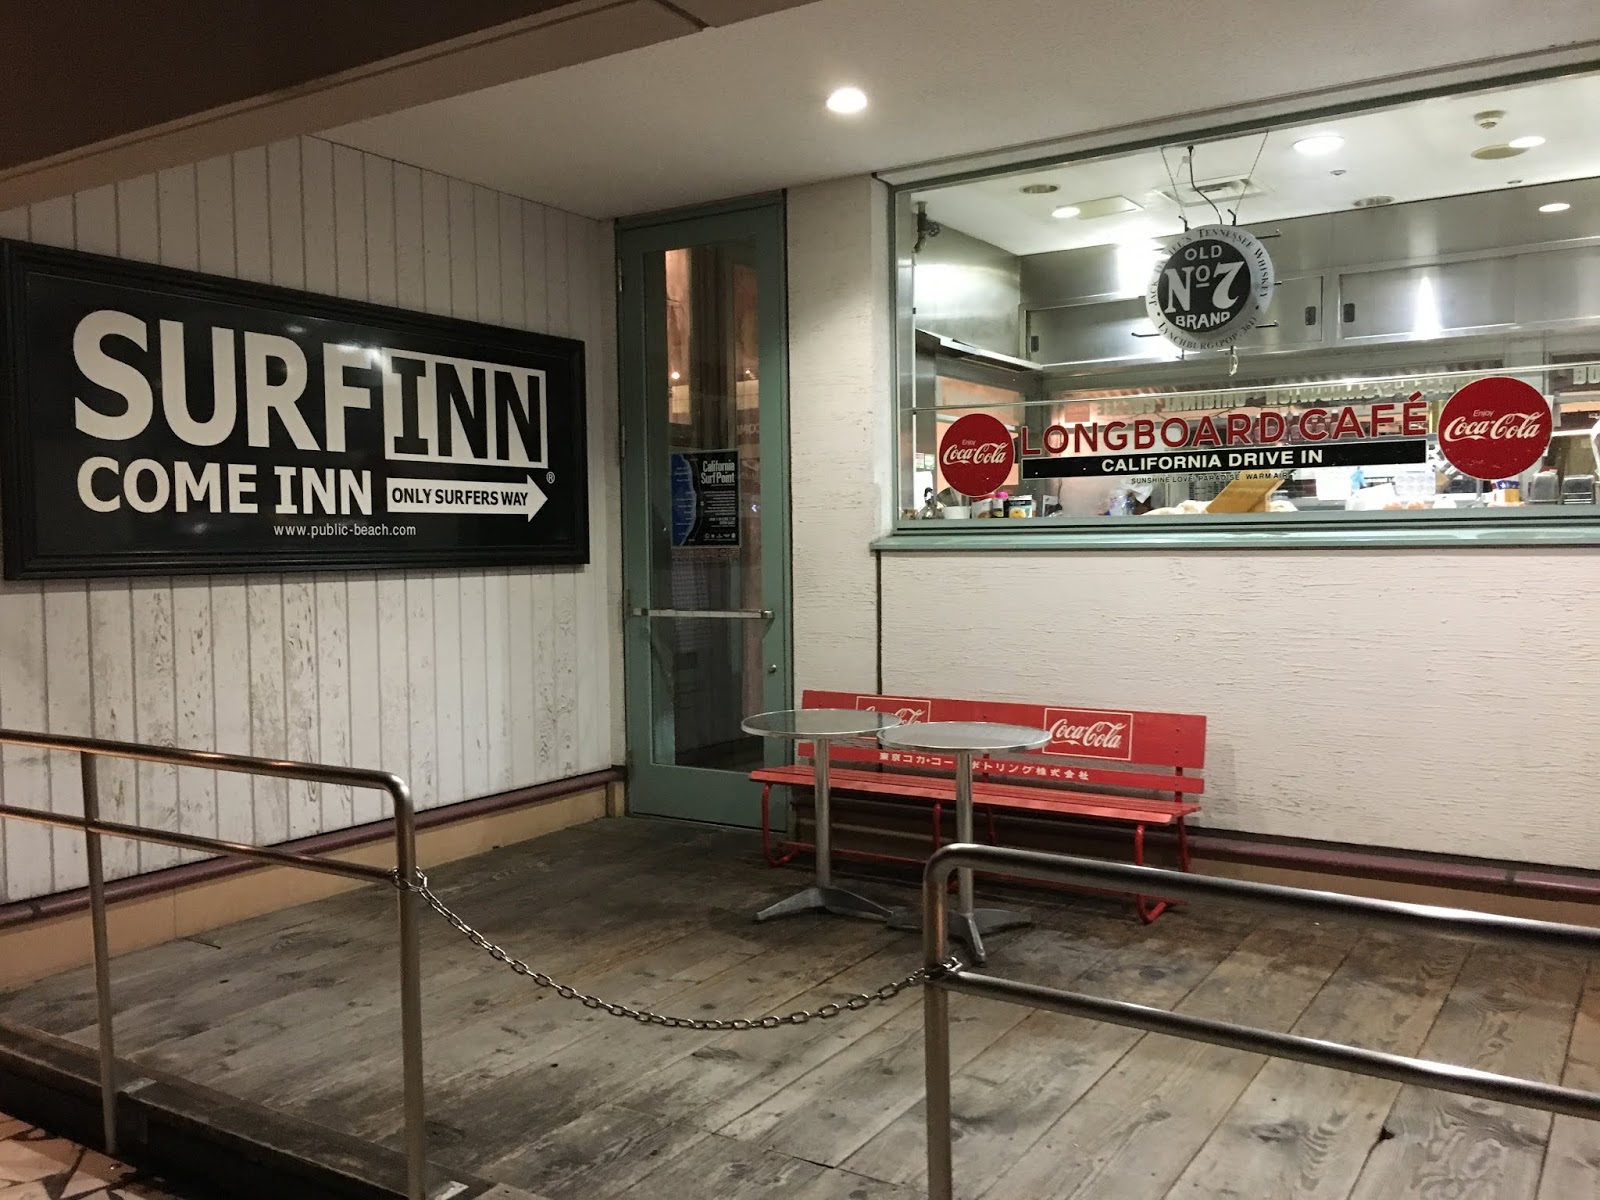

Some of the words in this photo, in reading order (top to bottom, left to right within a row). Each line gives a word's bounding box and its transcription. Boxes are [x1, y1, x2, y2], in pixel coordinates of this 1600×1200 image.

[1156, 235, 1192, 274] DAIEL'S
[1197, 228, 1254, 249] TENNESSEE
[1184, 245, 1222, 261] OLD
[1175, 311, 1230, 330] BRAND
[1473, 409, 1494, 418] Enjoy
[1021, 411, 1286, 456] LONGBOARD
[1299, 391, 1427, 442] CAFÉ
[1444, 411, 1545, 442] Coca-Cola
[943, 442, 1009, 465] Coca-Cola
[1101, 453, 1220, 472] CALIFORNIA
[1228, 450, 1294, 467] DRIVE
[1300, 448, 1323, 464] IN
[702, 459, 735, 472] California
[76, 456, 257, 514] COME
[274, 465, 372, 515] INN
[701, 472, 716, 484] Surf
[716, 471, 736, 483] Point
[1131, 476, 1170, 484] SUNSHINE
[391, 487, 433, 504] ONLY
[435, 489, 499, 506] SURFERS
[500, 491, 528, 506] WAY
[274, 523, 417, 538] www.public-beach.com
[1051, 718, 1127, 749] Coca-Cola
